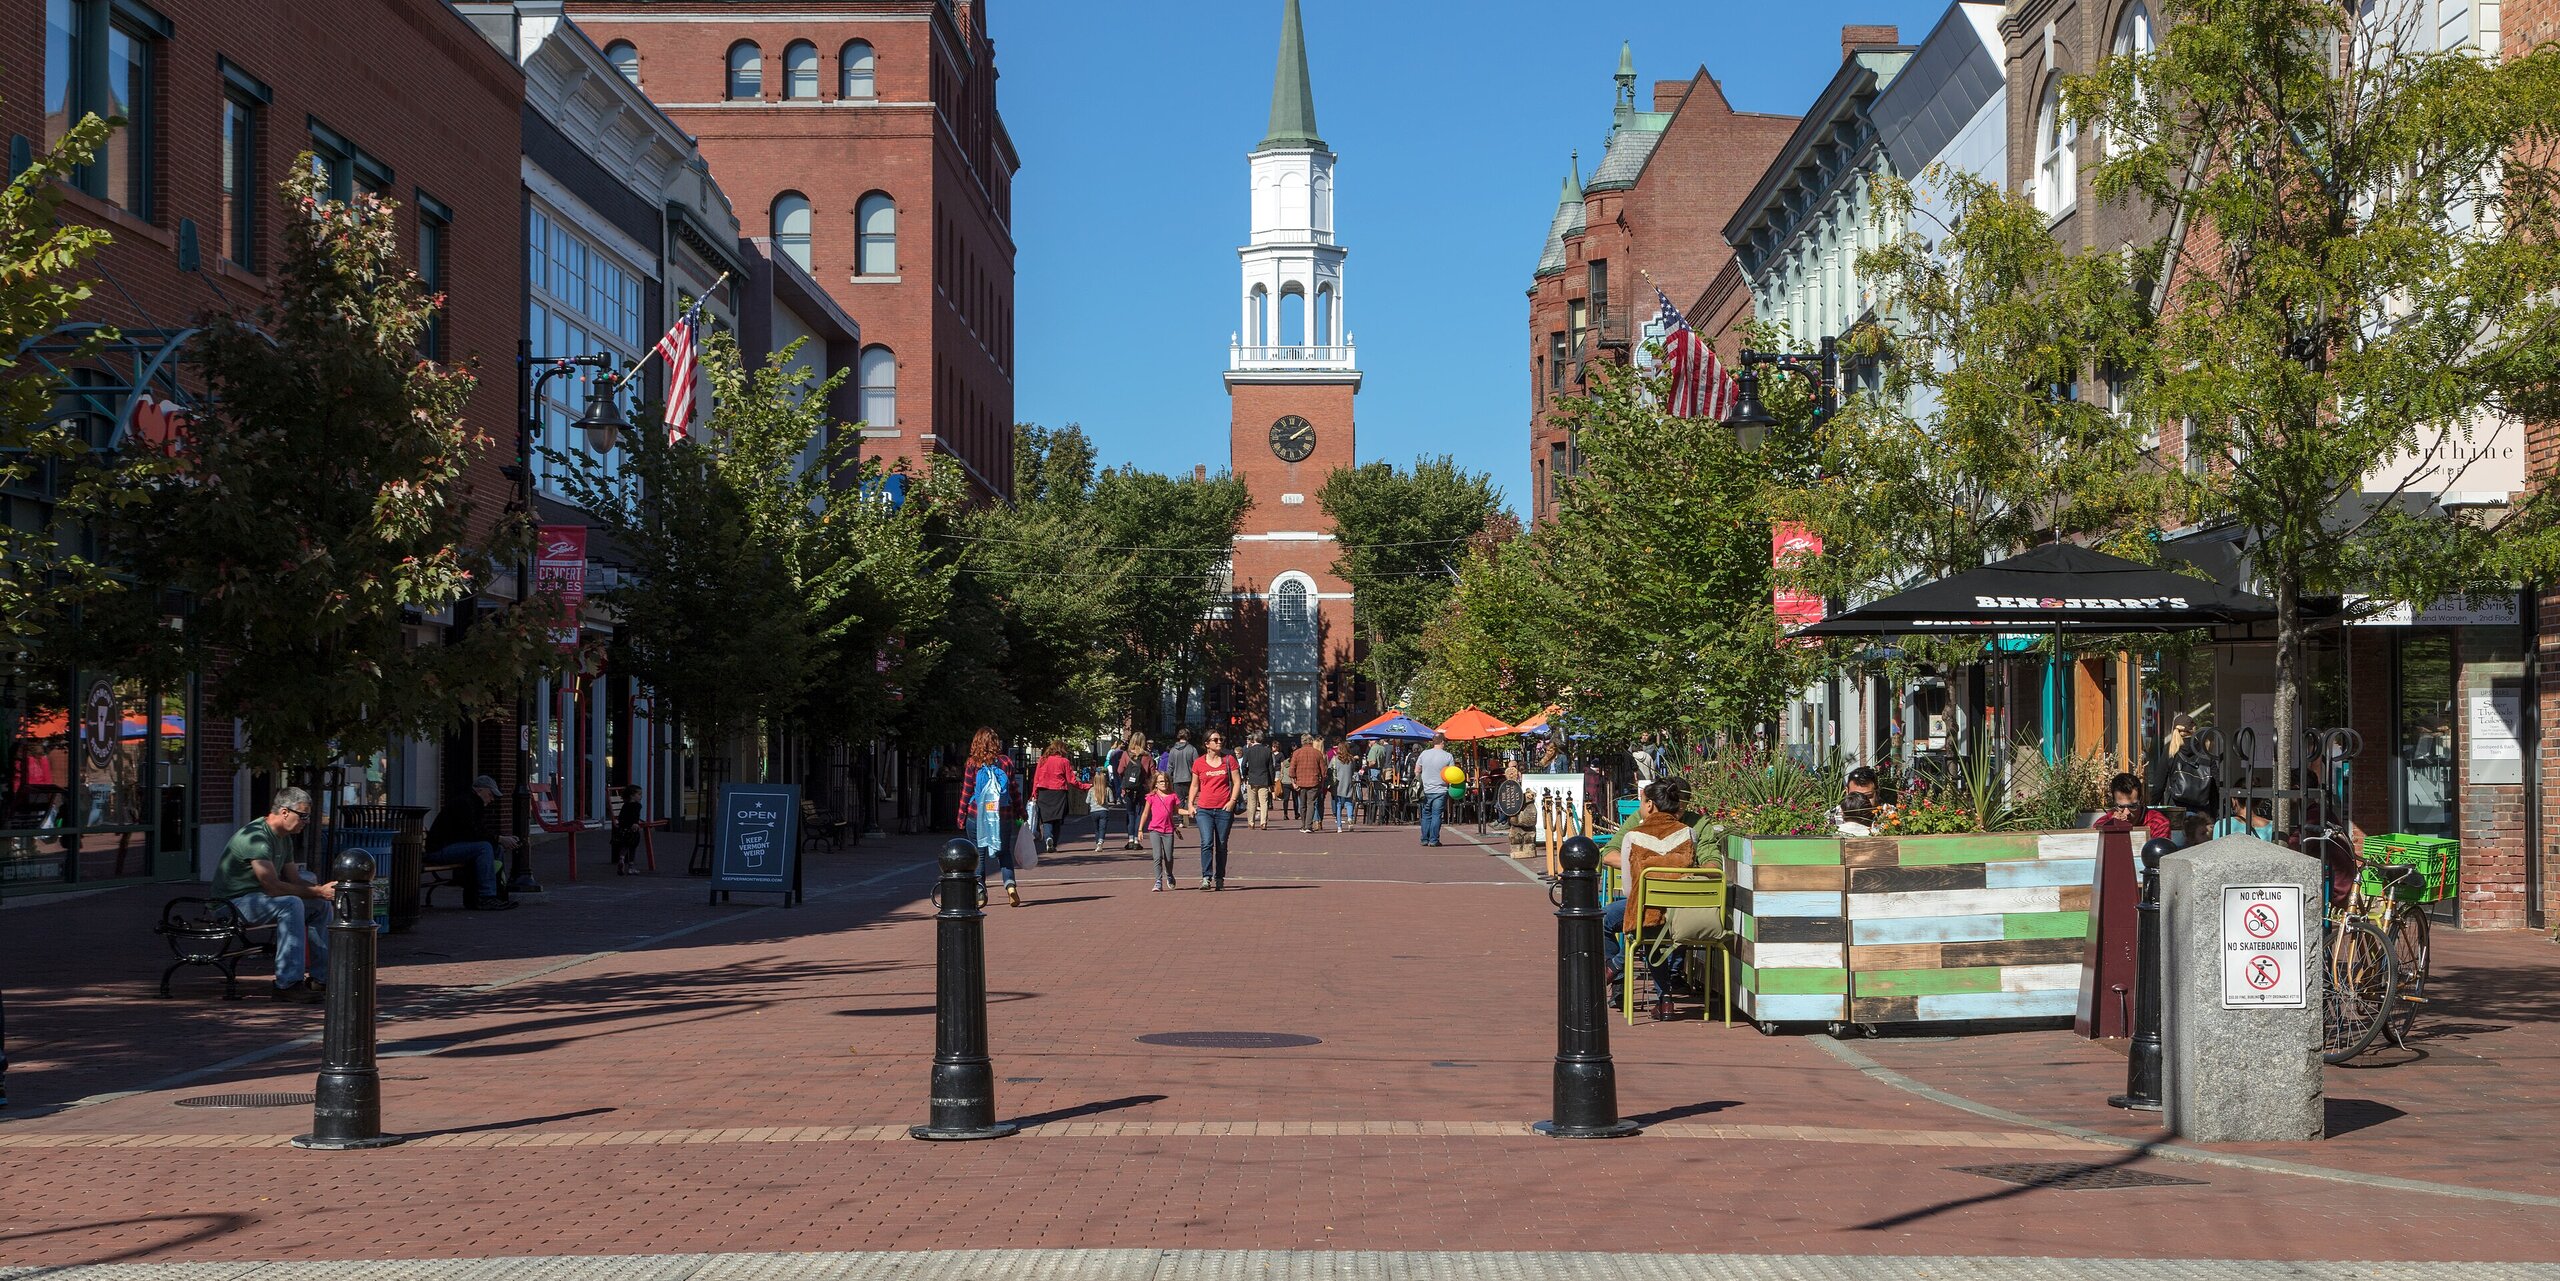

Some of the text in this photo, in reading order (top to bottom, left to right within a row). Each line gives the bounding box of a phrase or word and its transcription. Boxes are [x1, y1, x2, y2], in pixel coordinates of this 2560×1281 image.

[539, 567, 582, 580] CONCERT
[538, 581, 582, 591] SERES
[2421, 614, 2437, 622] and
[2438, 614, 2468, 622] Women
[2479, 614, 2494, 622] 2nd
[2495, 614, 2513, 622] Floor
[2406, 766, 2452, 782] TRINKET
[737, 810, 777, 819] OPEN
[739, 841, 770, 850] VERMONT
[743, 849, 765, 857] WEIRD
[2240, 892, 2250, 900] NO
[2227, 941, 2298, 951] NO SKATEBOARDING
